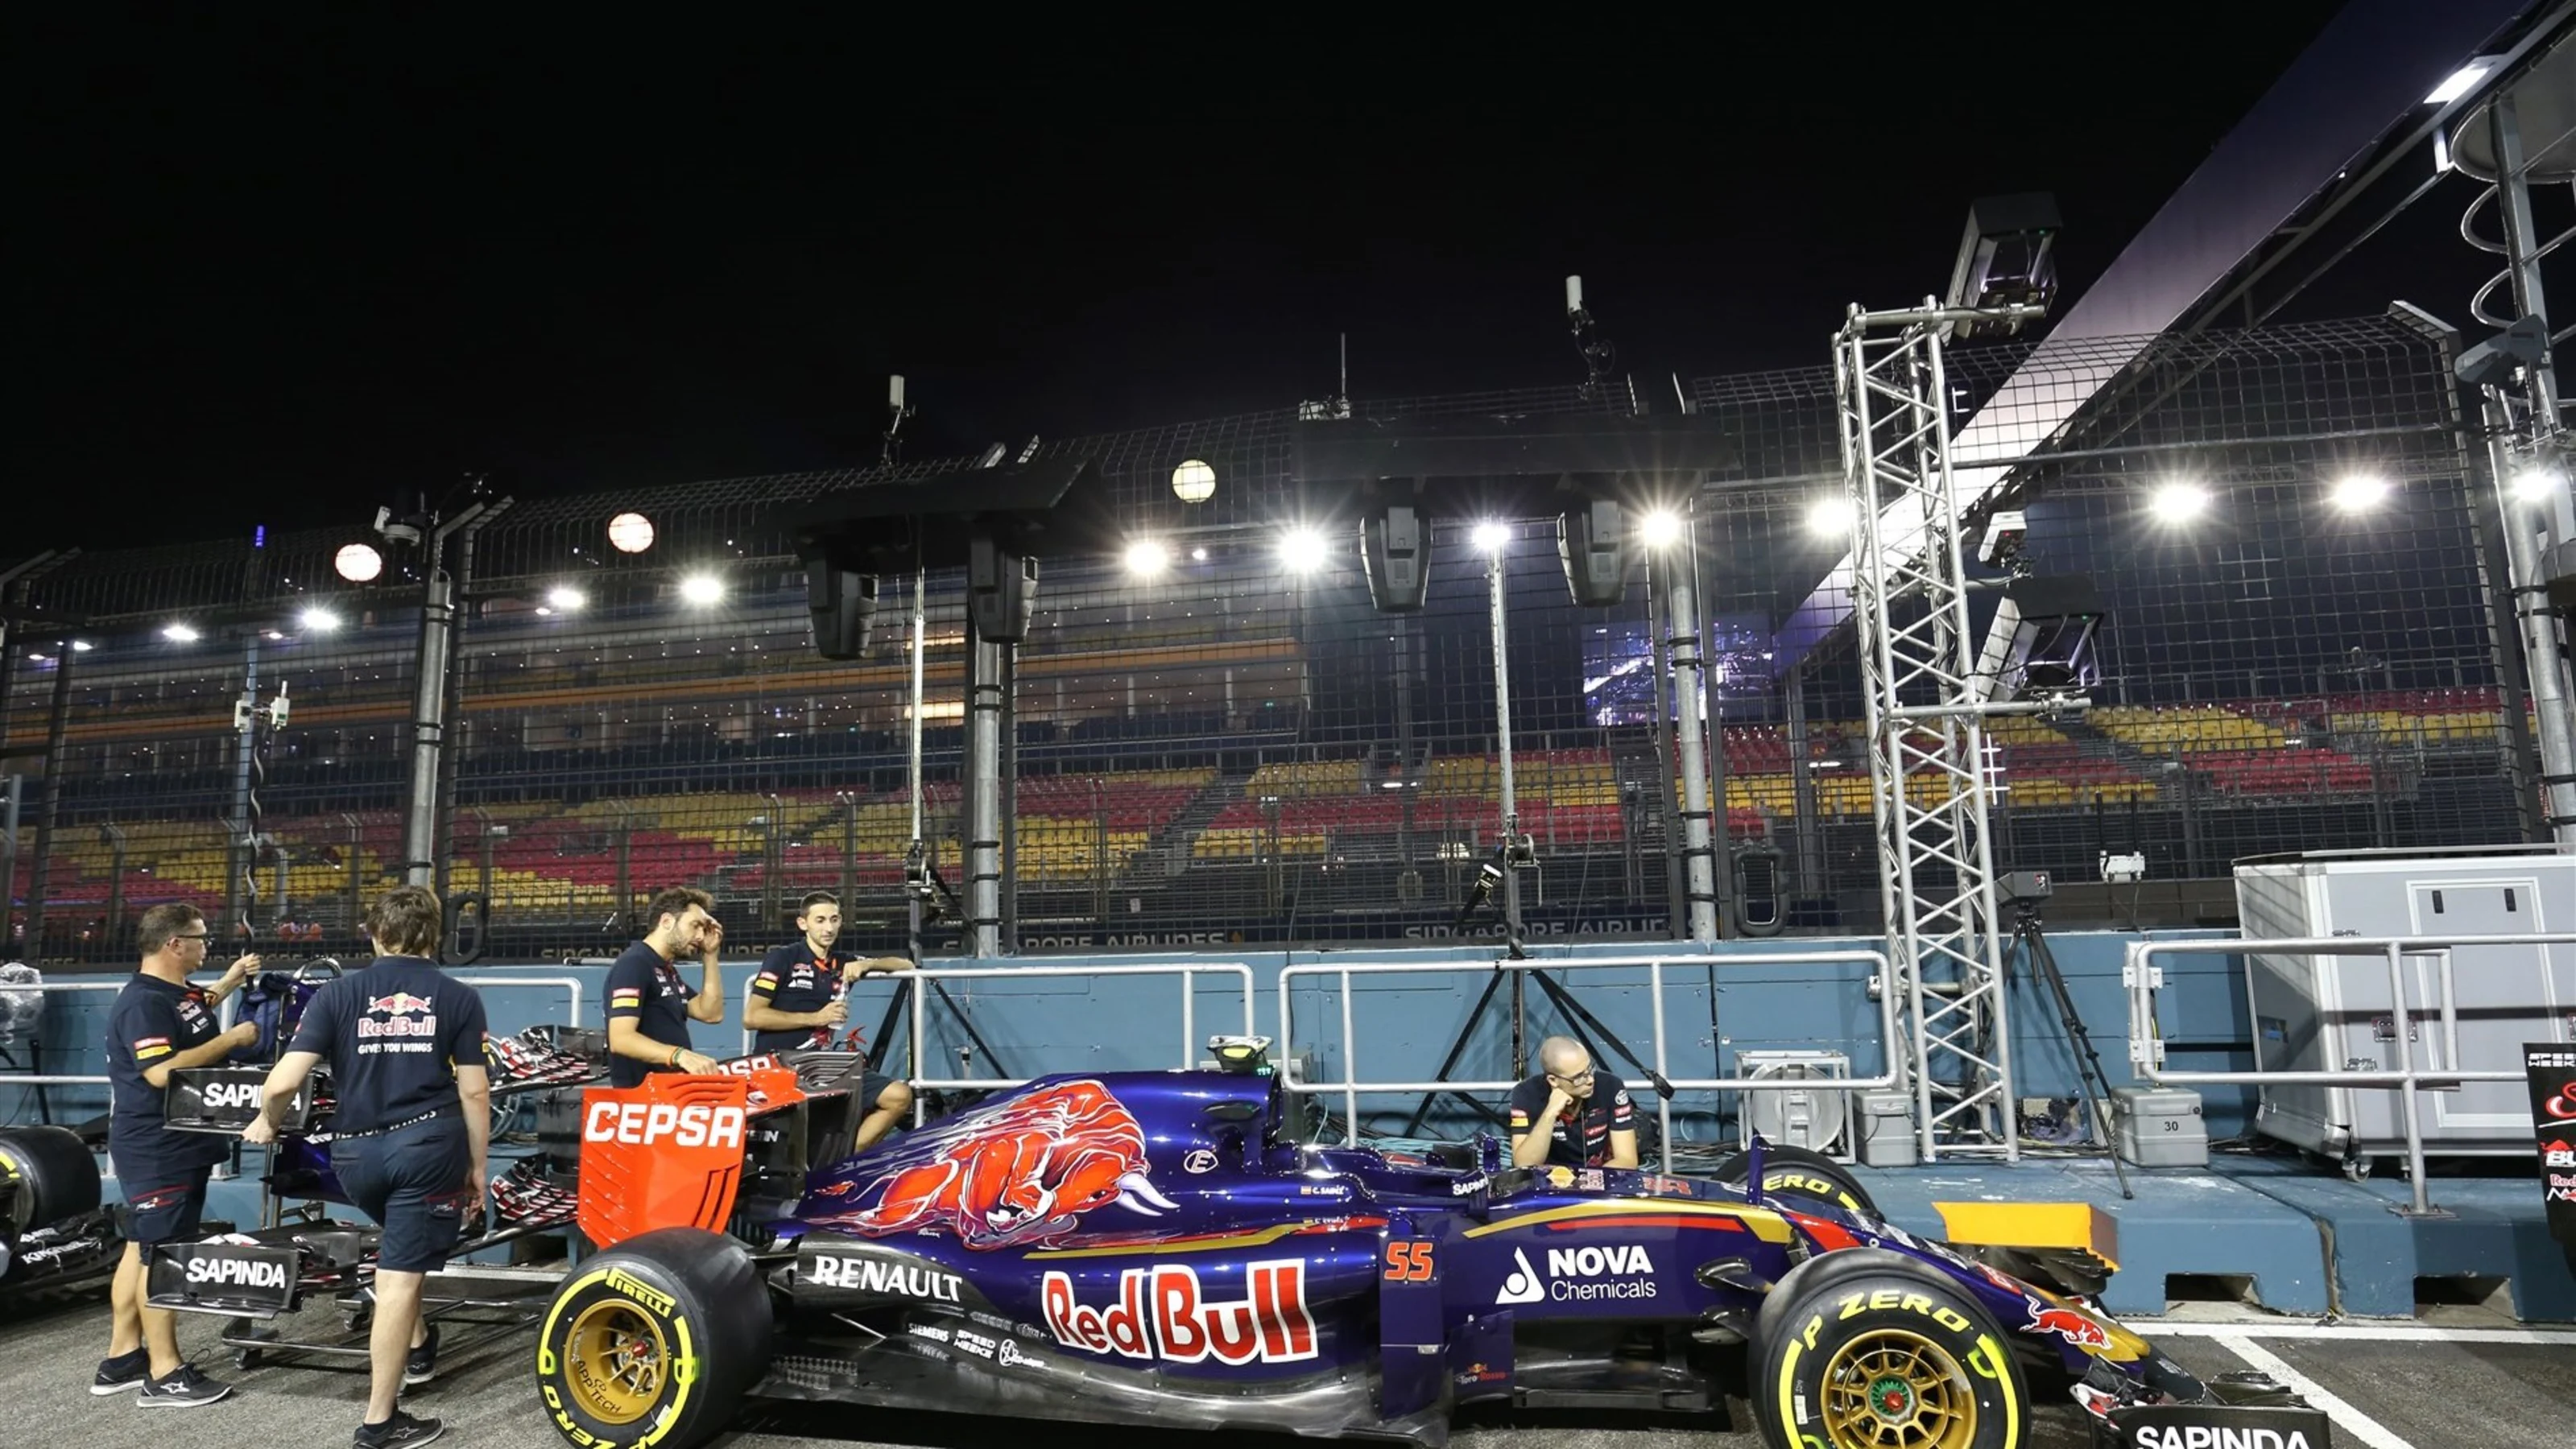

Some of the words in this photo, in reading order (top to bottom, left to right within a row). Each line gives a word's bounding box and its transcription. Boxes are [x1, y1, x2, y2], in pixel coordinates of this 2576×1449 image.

[203, 1083, 301, 1111] SAPIA
[585, 1100, 744, 1149] CEPSA
[2165, 1121, 2179, 1131] 30
[1763, 1174, 1833, 1195] ERO
[185, 1257, 285, 1289] SAPINDA
[1384, 1241, 1433, 1282] 55
[1548, 1245, 1654, 1277] NOVA
[605, 1267, 676, 1319] PIRELLI
[812, 1255, 962, 1302] RENAULT
[1551, 1278, 1656, 1302] Chemicals
[1041, 1268, 1153, 1360] Red
[1150, 1257, 1319, 1366] Bull
[1803, 1315, 1823, 1351] P
[1838, 1290, 1971, 1333] ZERO
[2136, 1426, 2310, 1449] SAPINDA
